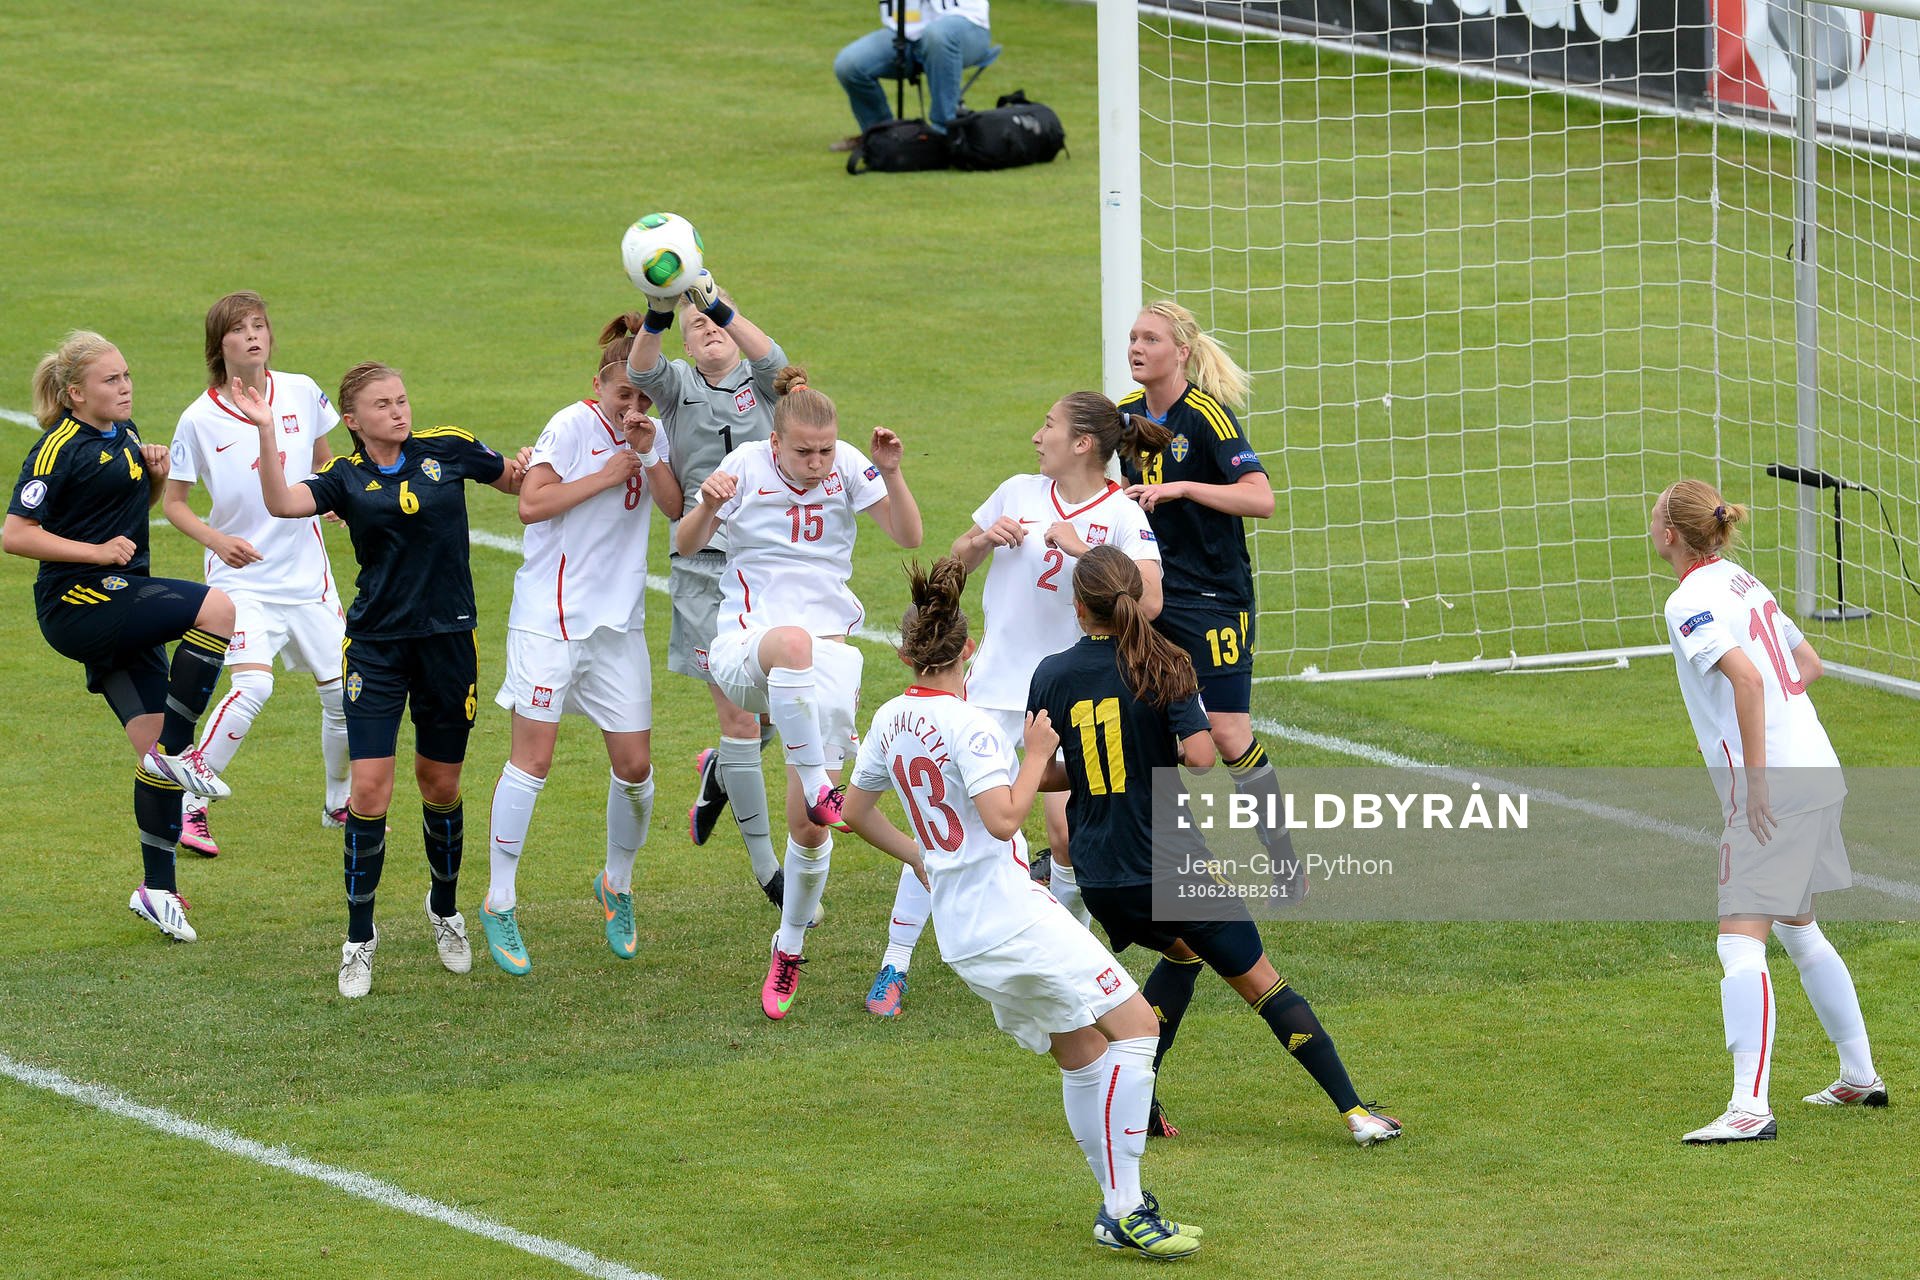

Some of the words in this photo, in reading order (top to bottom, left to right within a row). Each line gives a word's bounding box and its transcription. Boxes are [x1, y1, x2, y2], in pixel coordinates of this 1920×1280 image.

[718, 425, 733, 455] 1
[123, 447, 143, 480] 4
[400, 480, 420, 514] 6
[625, 473, 642, 510] 8
[785, 504, 824, 543] 15
[1036, 549, 1064, 592] 2
[1206, 627, 1239, 666] 13
[1749, 600, 1806, 701] 10
[465, 683, 477, 720] 6
[1070, 697, 1126, 795] 11
[892, 754, 964, 852] 13
